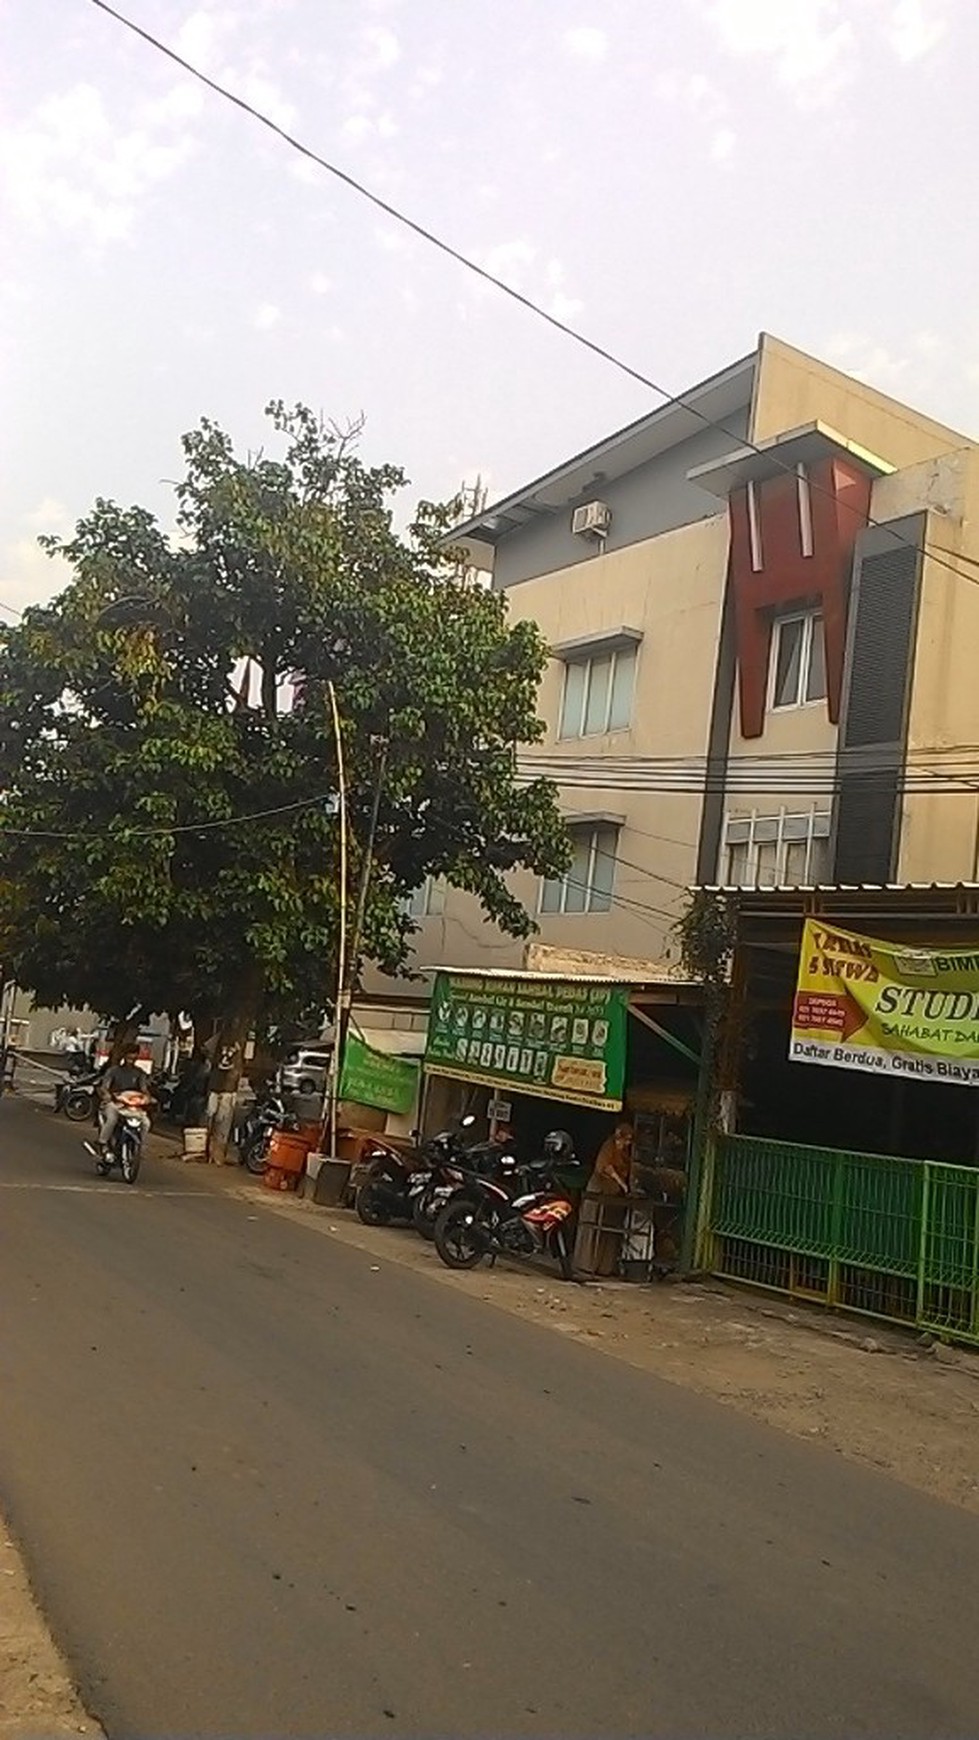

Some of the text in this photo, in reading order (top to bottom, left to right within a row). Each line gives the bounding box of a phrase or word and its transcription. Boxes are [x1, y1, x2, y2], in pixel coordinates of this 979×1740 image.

[882, 1023, 953, 1042] SAHABAT
[793, 1043, 831, 1058] Daftar
[833, 1048, 887, 1069] Berdua,
[892, 1057, 934, 1075] Gratis
